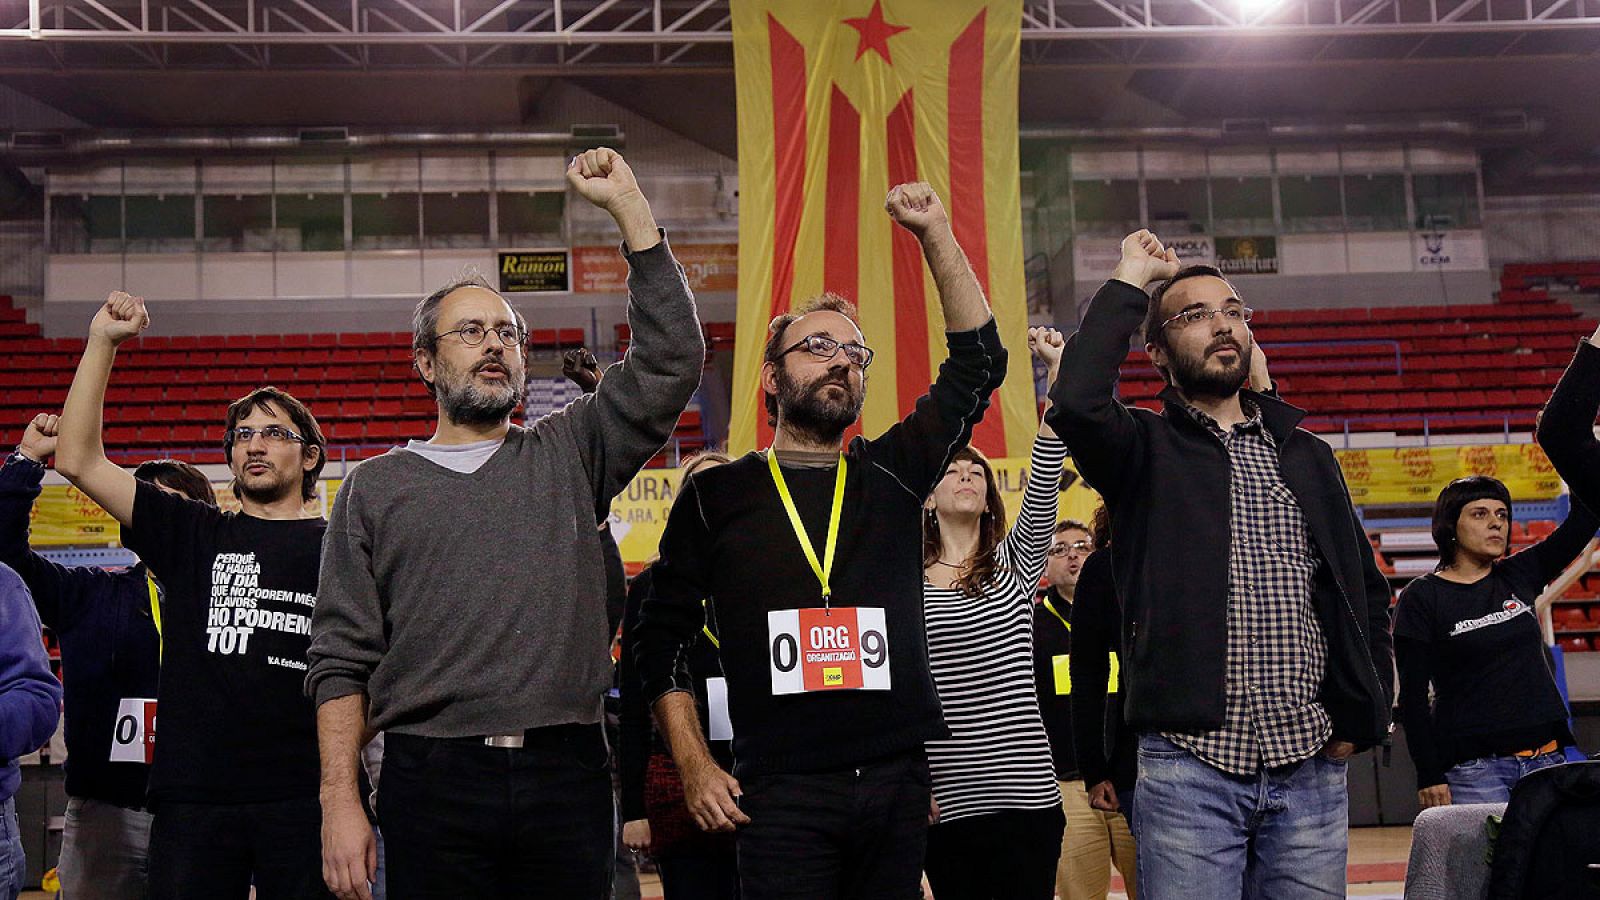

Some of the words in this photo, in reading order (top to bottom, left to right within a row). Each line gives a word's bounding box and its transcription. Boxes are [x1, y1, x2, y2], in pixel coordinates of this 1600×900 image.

[212, 570, 231, 585] UN
[233, 574, 259, 588] DIA
[211, 585, 229, 597] QUE
[230, 586, 246, 597] NO
[248, 588, 293, 602] PODREM
[295, 592, 317, 607] MÉS
[214, 597, 258, 609] LLAVORS
[208, 607, 230, 628] HO
[234, 608, 312, 636] PODREM
[206, 626, 254, 655] TOT
[810, 626, 849, 649] ORG
[861, 630, 887, 668] 9
[772, 633, 798, 672] 0
[806, 650, 856, 663] ORGANITZACIÓ
[116, 715, 138, 744] 0
